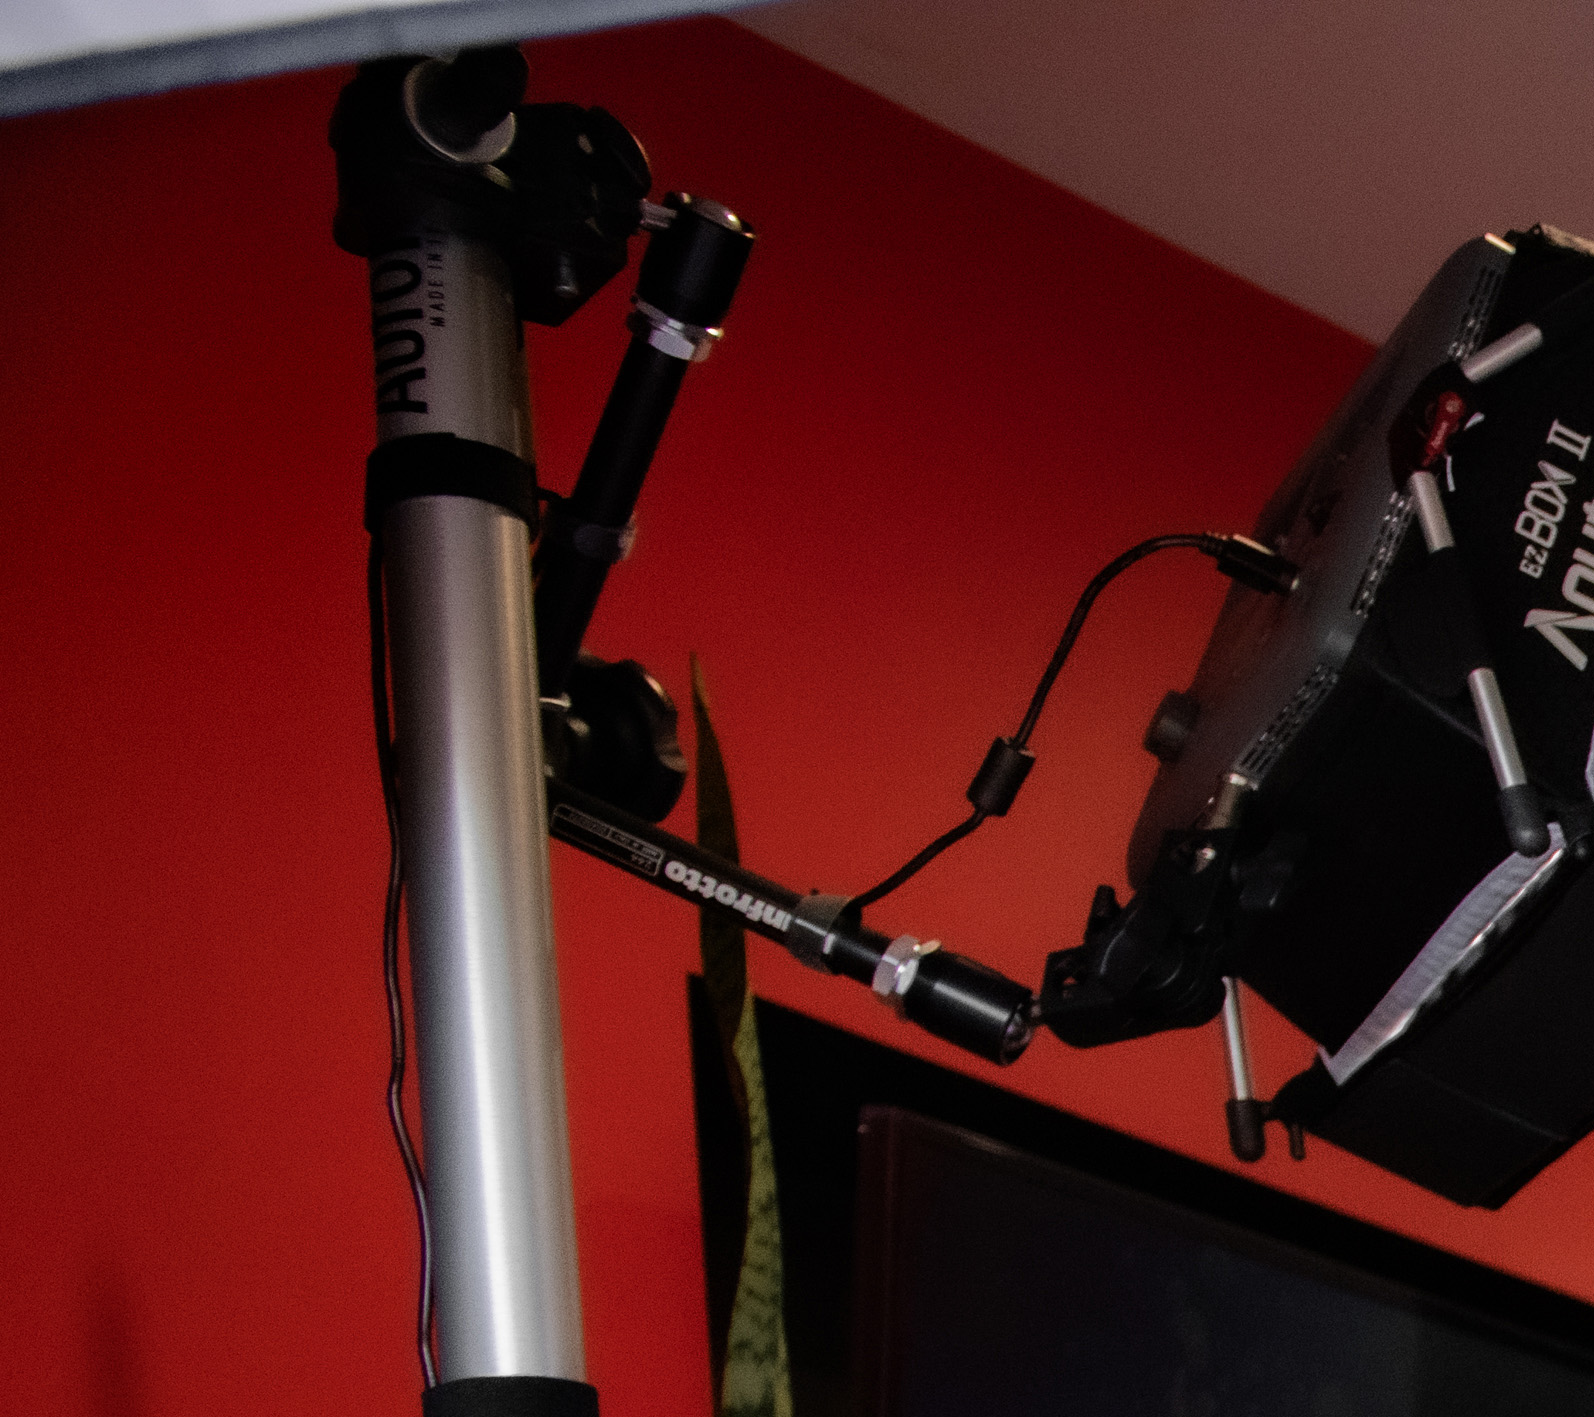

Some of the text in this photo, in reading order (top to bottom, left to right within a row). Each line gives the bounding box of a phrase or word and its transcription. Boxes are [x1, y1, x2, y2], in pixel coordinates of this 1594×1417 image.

[427, 279, 446, 328] MADE
[1546, 417, 1592, 461] II
[664, 860, 837, 955] nfrotto
